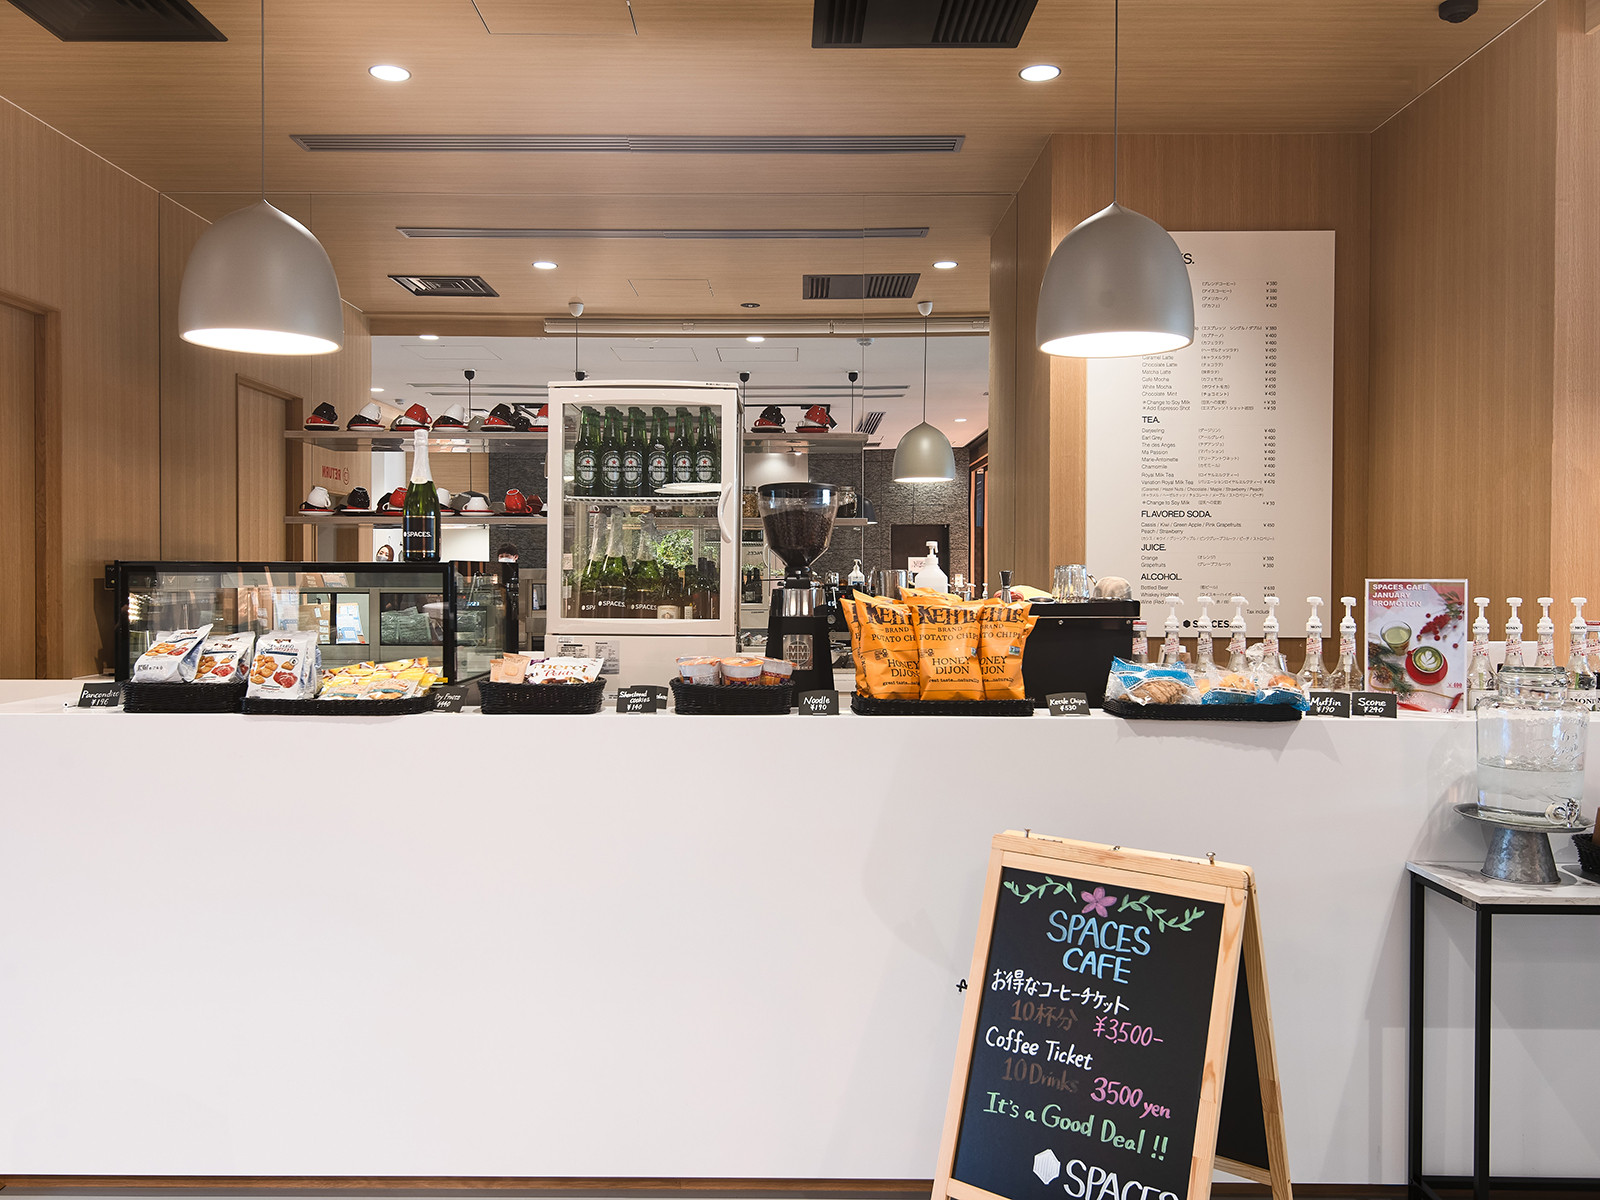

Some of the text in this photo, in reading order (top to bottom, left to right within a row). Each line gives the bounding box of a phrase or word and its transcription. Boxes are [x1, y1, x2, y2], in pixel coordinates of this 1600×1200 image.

[872, 634, 901, 642] POTATO
[888, 659, 920, 670] HONEY
[932, 656, 971, 666] HONEY
[979, 656, 1007, 665] ONEY
[534, 663, 588, 673] merci
[935, 666, 970, 675] DIJON
[803, 696, 830, 705] Noodle
[1049, 697, 1068, 706] Kettle
[1309, 697, 1342, 707] Muffin
[1358, 698, 1387, 707] Scone
[1047, 910, 1150, 956] SPACES
[1063, 948, 1131, 984] CAFE
[991, 969, 1130, 1014] お得なコーヒーチケット
[1011, 1000, 1078, 1031] 10杯分
[985, 1026, 1093, 1070] Coffee Ticket
[1090, 1076, 1143, 1107] 3500
[1139, 1102, 1171, 1119] yen
[983, 1091, 1020, 1119] It's
[1024, 1108, 1037, 1123] a
[1041, 1104, 1094, 1137] Good
[1101, 1119, 1145, 1154] Deal
